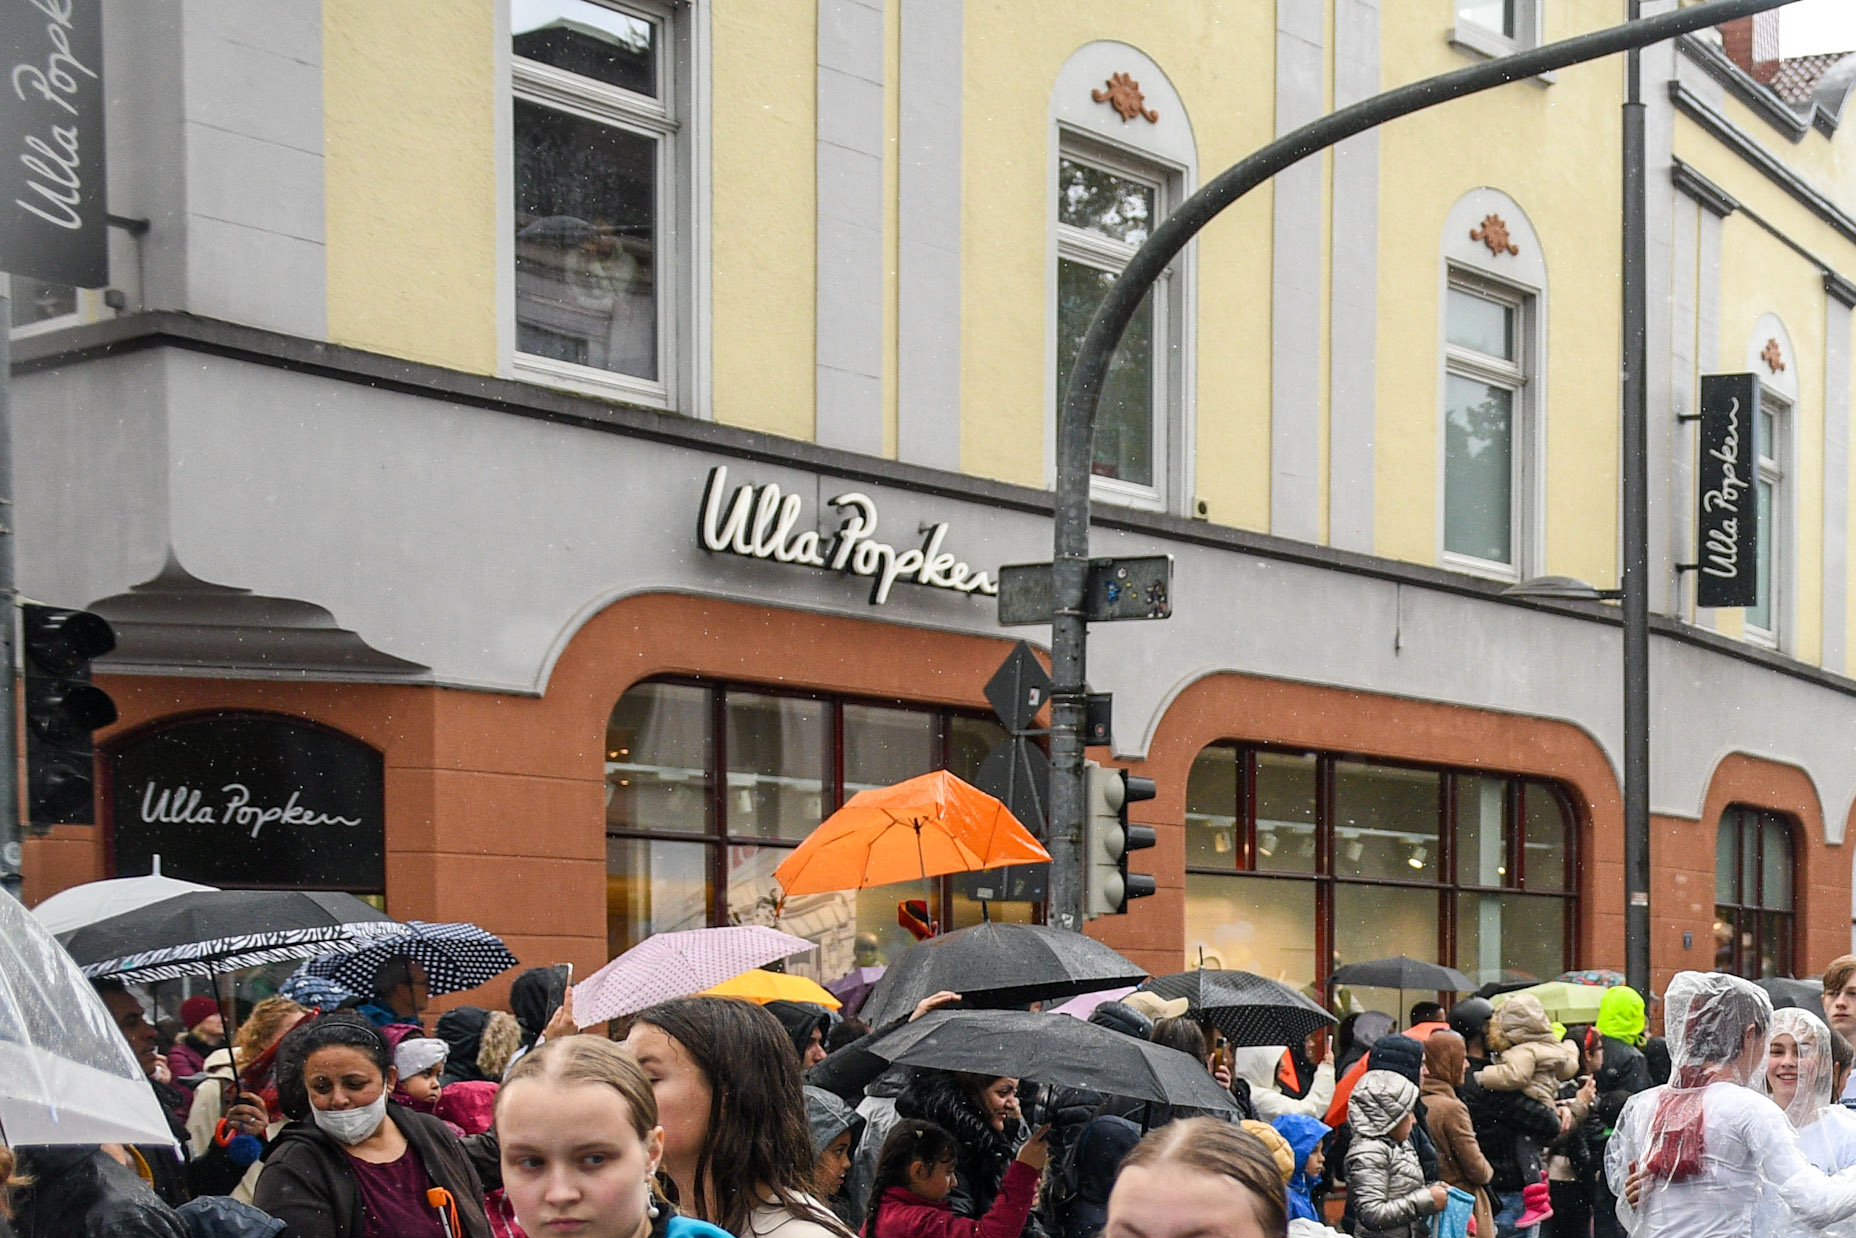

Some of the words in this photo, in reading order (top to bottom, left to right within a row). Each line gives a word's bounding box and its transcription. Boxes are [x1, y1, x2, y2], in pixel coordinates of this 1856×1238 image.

[12, 0, 98, 116] Popk
[16, 124, 83, 230] Ulla
[1703, 396, 1749, 513] Popken
[701, 464, 825, 566] Ulla
[1702, 517, 1738, 578] Ulla
[141, 781, 216, 824] Ulla
[221, 783, 362, 839] Popken
